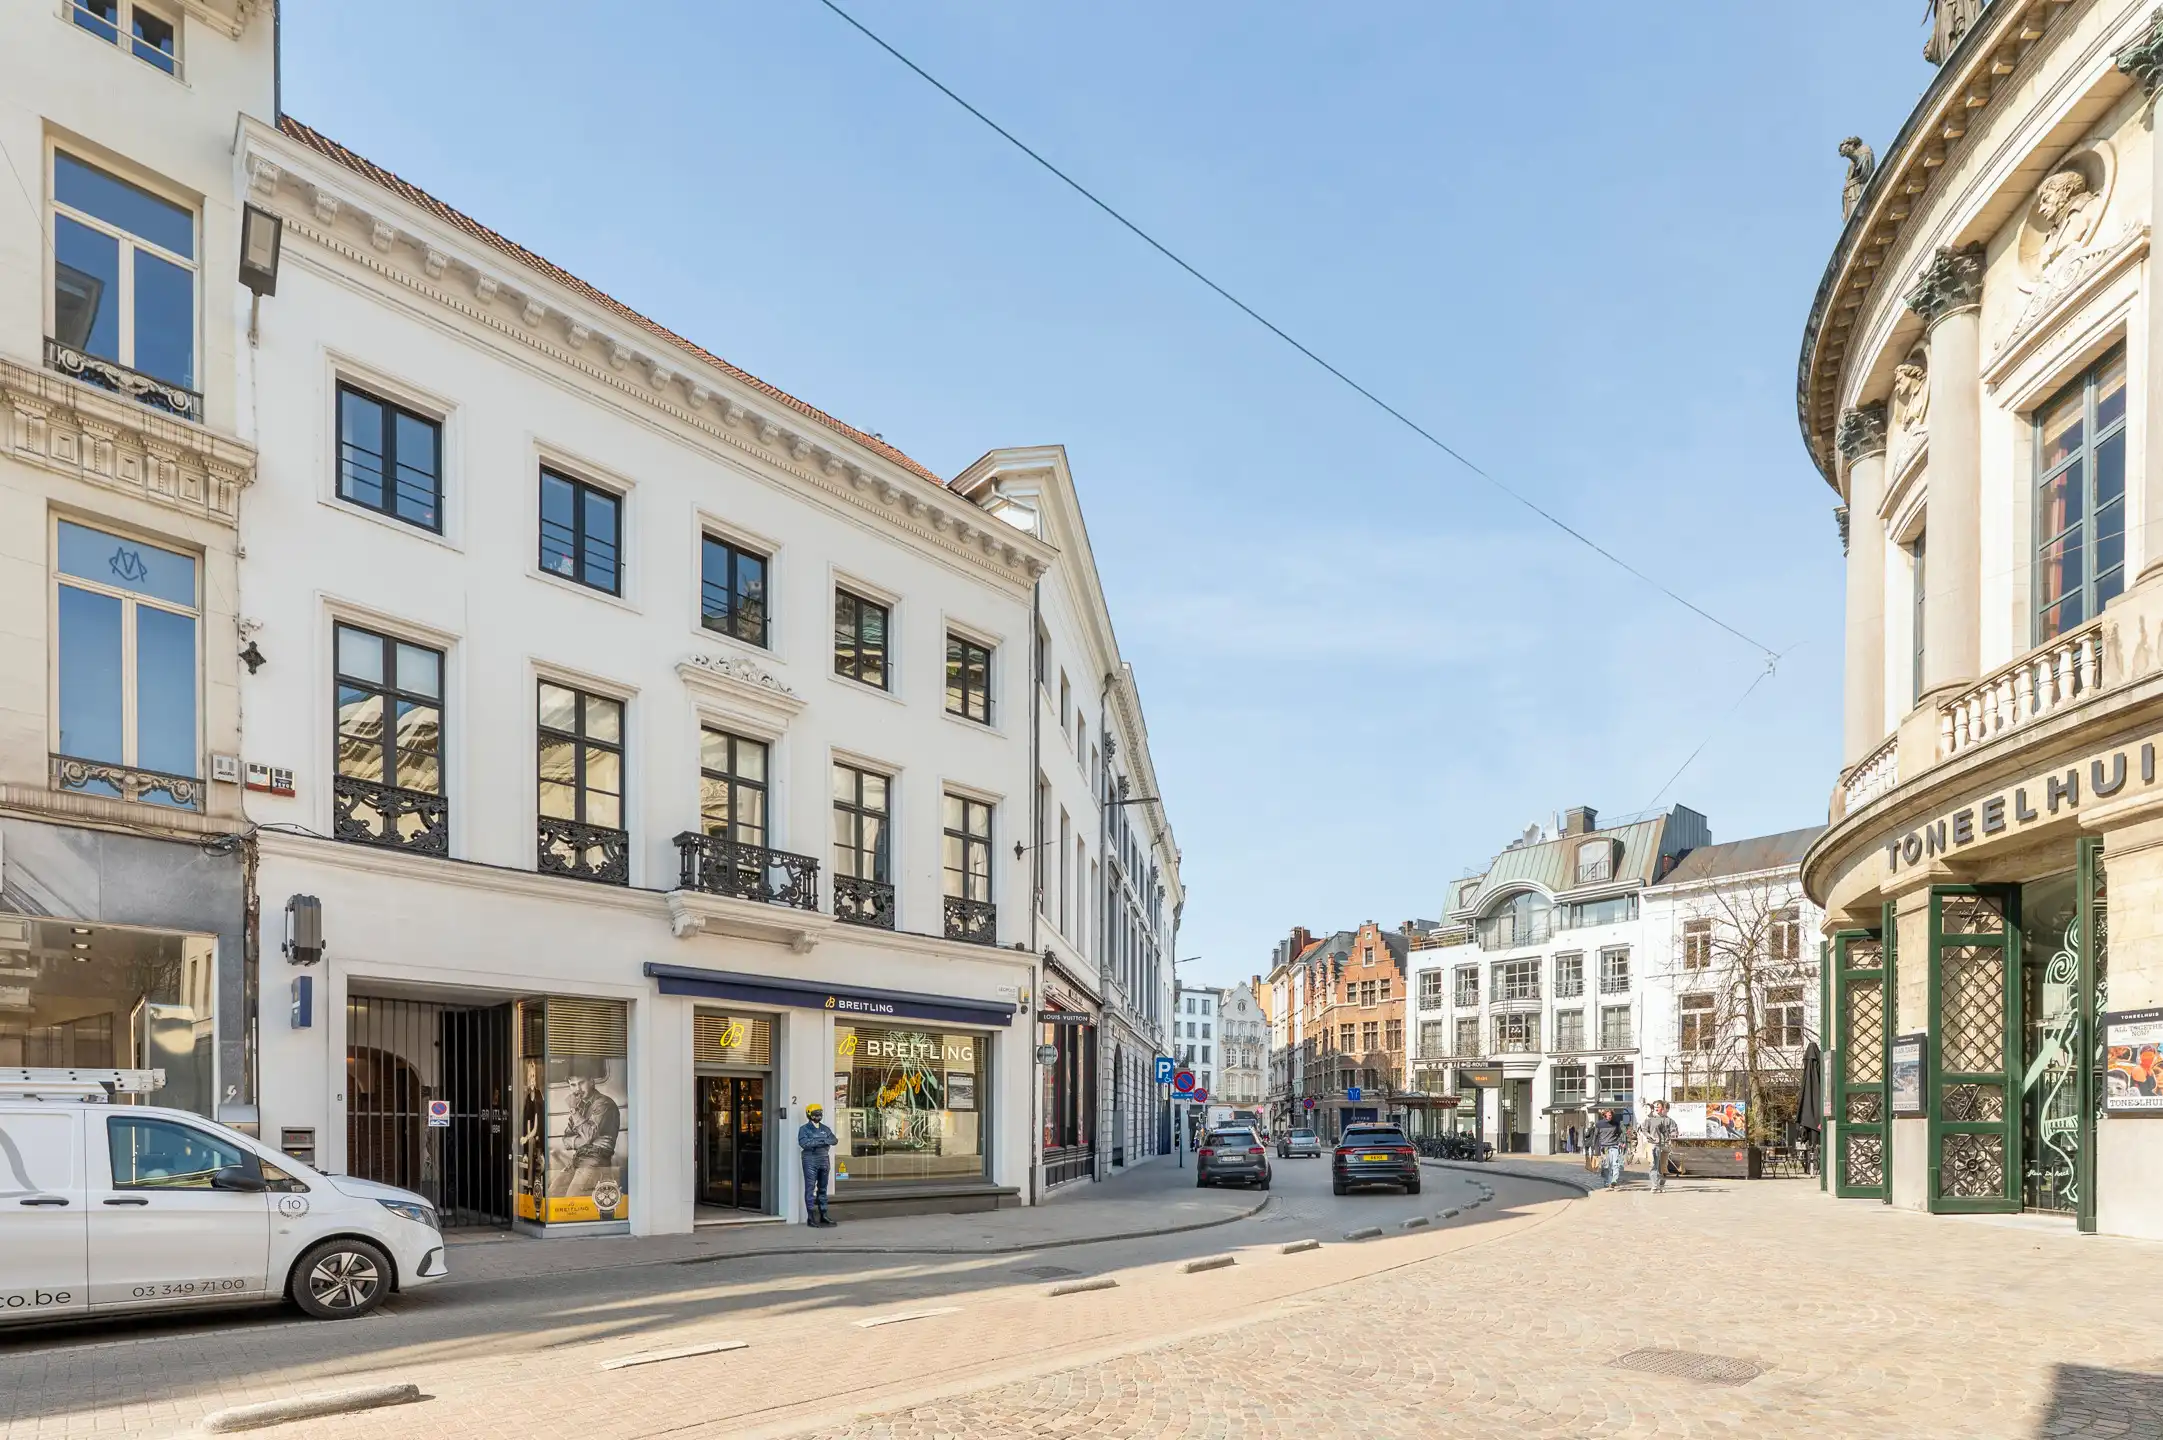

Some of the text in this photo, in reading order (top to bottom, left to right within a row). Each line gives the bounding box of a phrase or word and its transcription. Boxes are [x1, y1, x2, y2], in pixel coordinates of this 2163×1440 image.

[838, 1000, 894, 1013] BREITLING
[2120, 1011, 2160, 1020] TONEELHUIS
[867, 1040, 974, 1062] BREITLING
[1158, 1061, 1172, 1079] P
[791, 1096, 798, 1105] 2
[287, 1198, 301, 1210] 10
[132, 1286, 156, 1298] 03
[161, 1283, 196, 1296] 349
[199, 1281, 217, 1293] 71
[221, 1278, 245, 1291] 00
